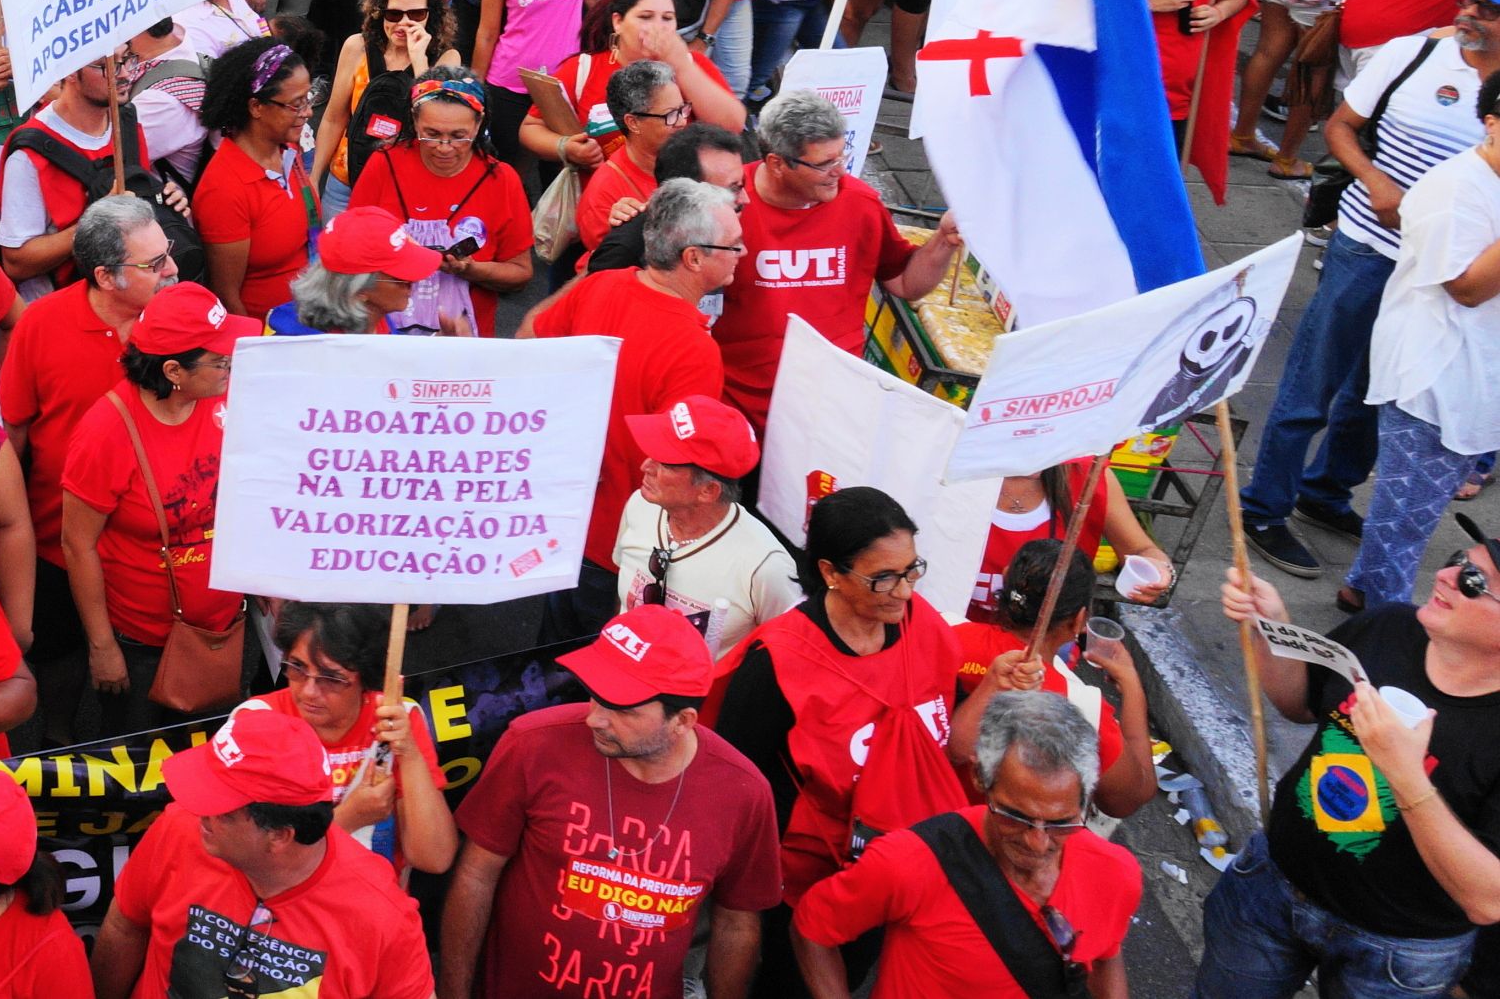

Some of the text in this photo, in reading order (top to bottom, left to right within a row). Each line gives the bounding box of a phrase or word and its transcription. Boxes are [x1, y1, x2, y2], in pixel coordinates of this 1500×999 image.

[756, 245, 846, 280] CUT BRASIL
[413, 380, 492, 399] SINPROJA
[1003, 382, 1114, 419] SINPROJA
[300, 405, 547, 435] JABOATÃO DOS
[308, 448, 531, 473] GUARARAPES
[297, 473, 533, 503] NA LUTA PELA
[270, 507, 548, 545] VALORIZAÇÃO DA
[309, 547, 487, 580] EDUCAÇÃO
[1259, 620, 1274, 633] Ei
[1278, 626, 1298, 638] da
[572, 861, 622, 883] REFORMA
[623, 873, 638, 888] DA
[567, 875, 696, 914] EU DIGO NÃO
[622, 908, 666, 925] SINPROJA
[190, 907, 322, 965] III CONERÊNCIA
[192, 923, 310, 974] DE EDCAÇÃO
[189, 934, 305, 986] DO SNPROJA
